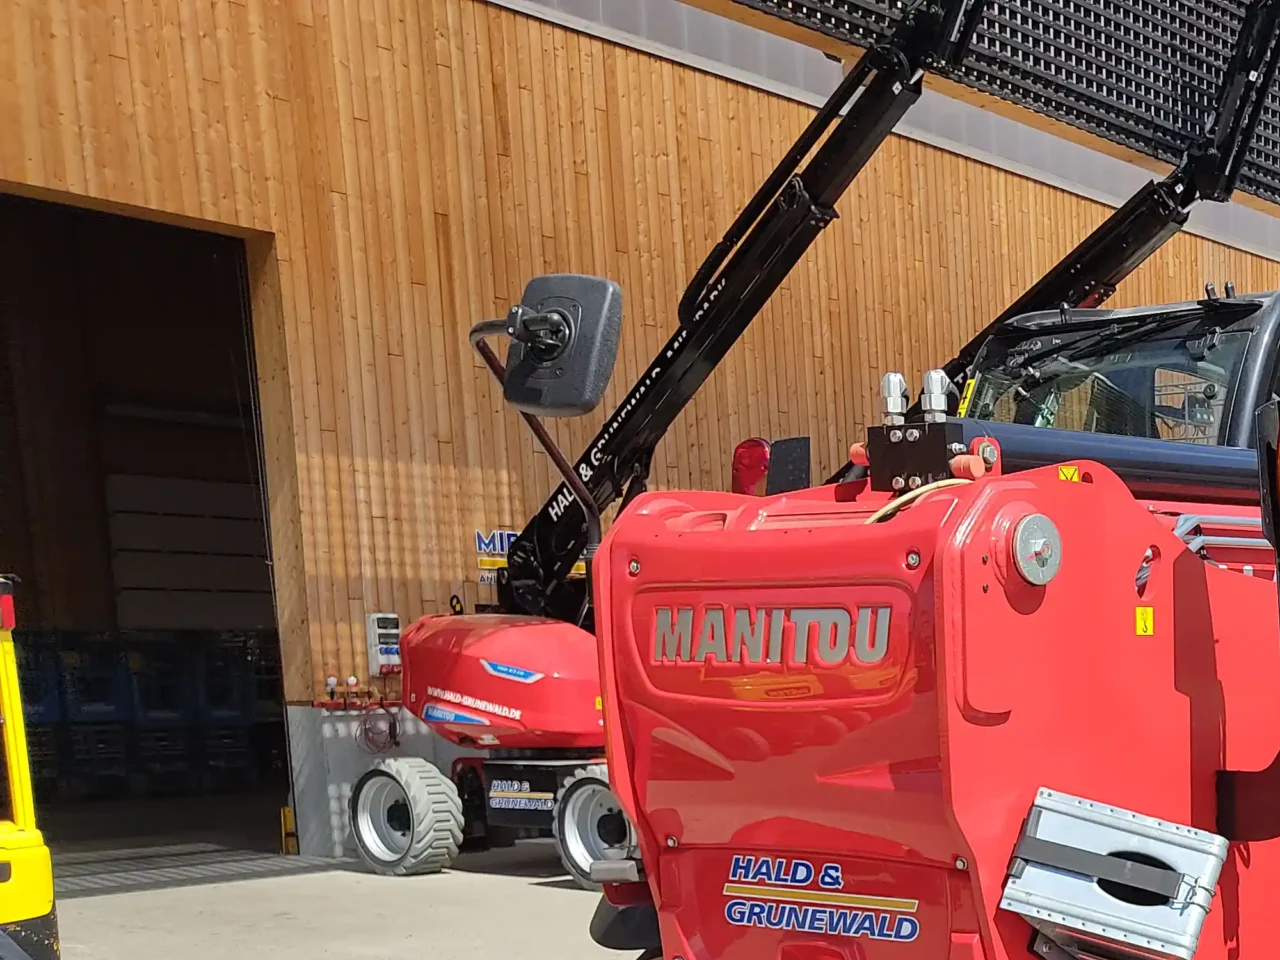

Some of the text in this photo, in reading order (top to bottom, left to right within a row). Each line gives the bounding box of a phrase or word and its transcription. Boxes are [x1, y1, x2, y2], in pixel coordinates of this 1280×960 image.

[652, 606, 892, 664] MANITOU
[491, 780, 530, 792] HALD &
[490, 798, 554, 810] GRUNEWALD
[730, 855, 843, 889] HALD &
[724, 900, 919, 942] GRUNEWALD
